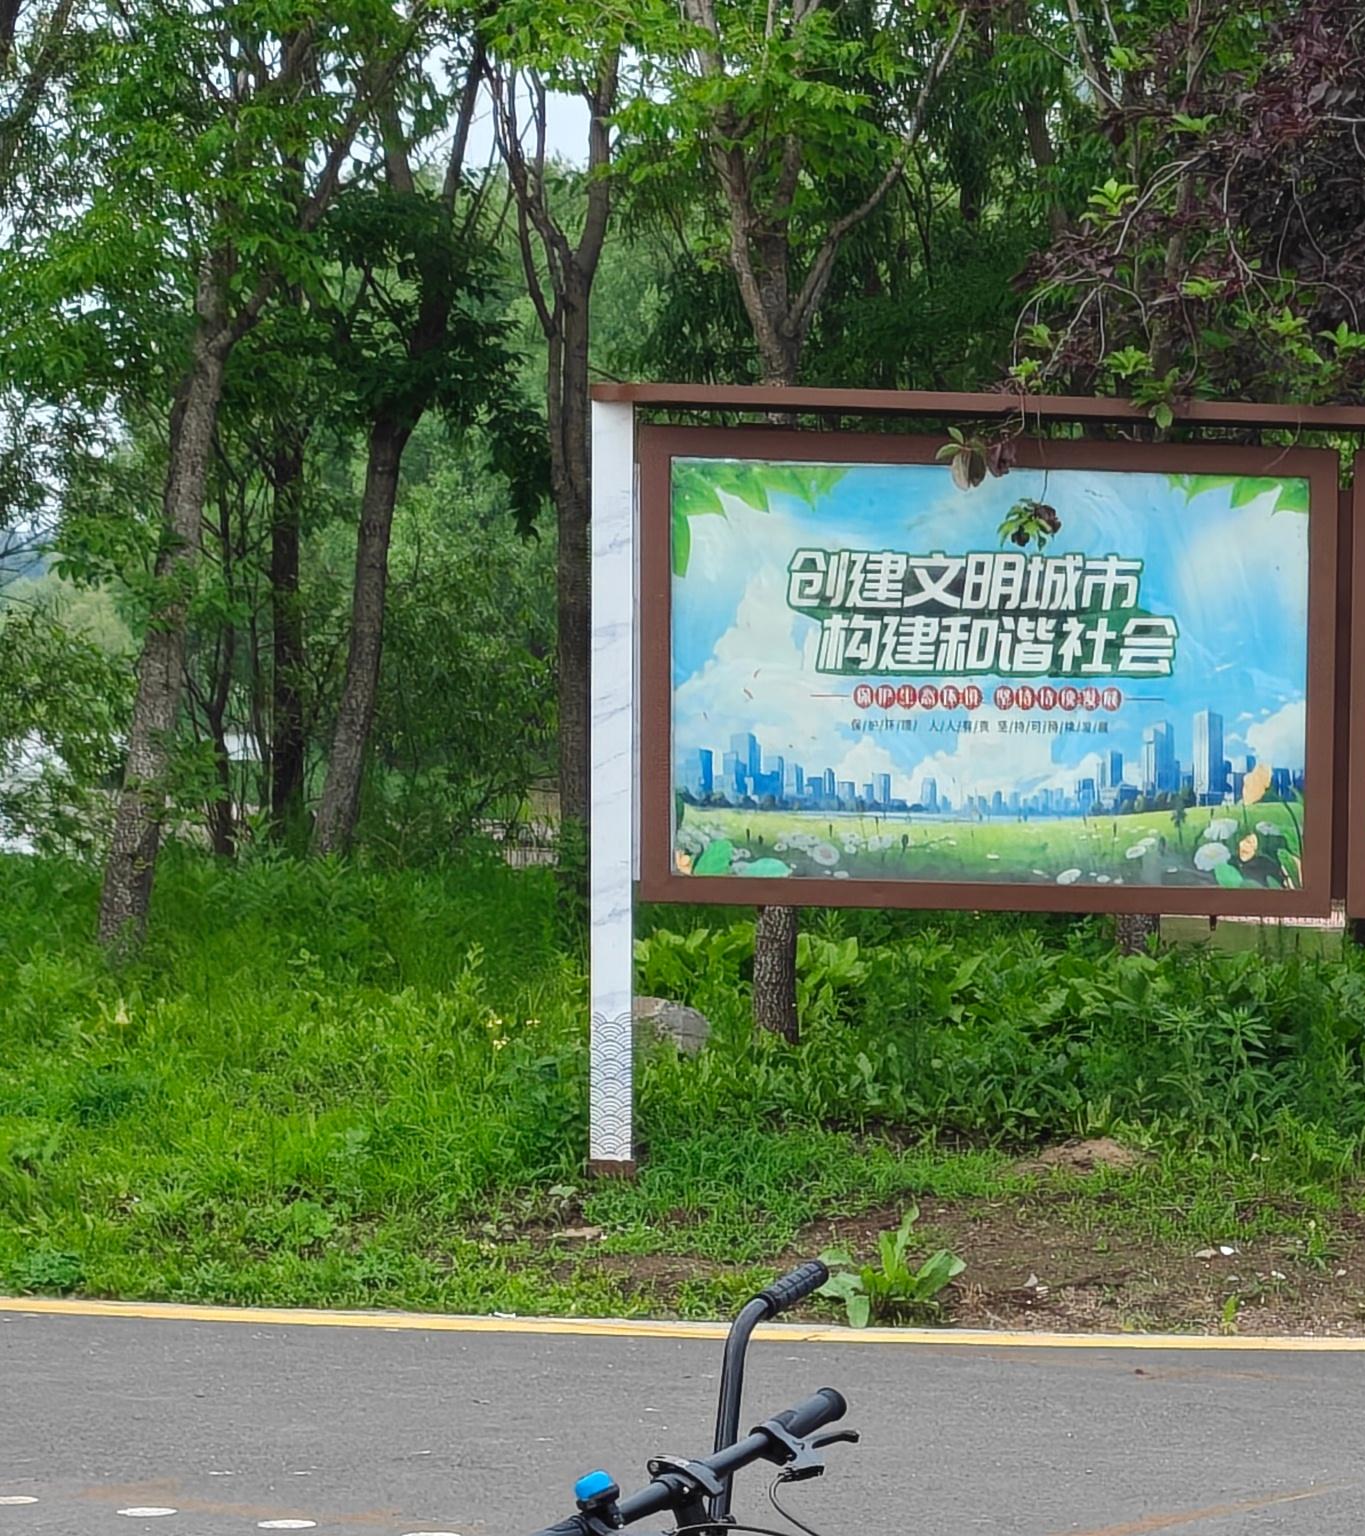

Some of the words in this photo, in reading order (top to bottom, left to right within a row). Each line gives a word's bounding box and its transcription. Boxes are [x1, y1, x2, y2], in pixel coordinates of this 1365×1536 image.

[789, 552, 1142, 610] 创建文明城市
[820, 614, 1177, 673] 构建和谐社会
